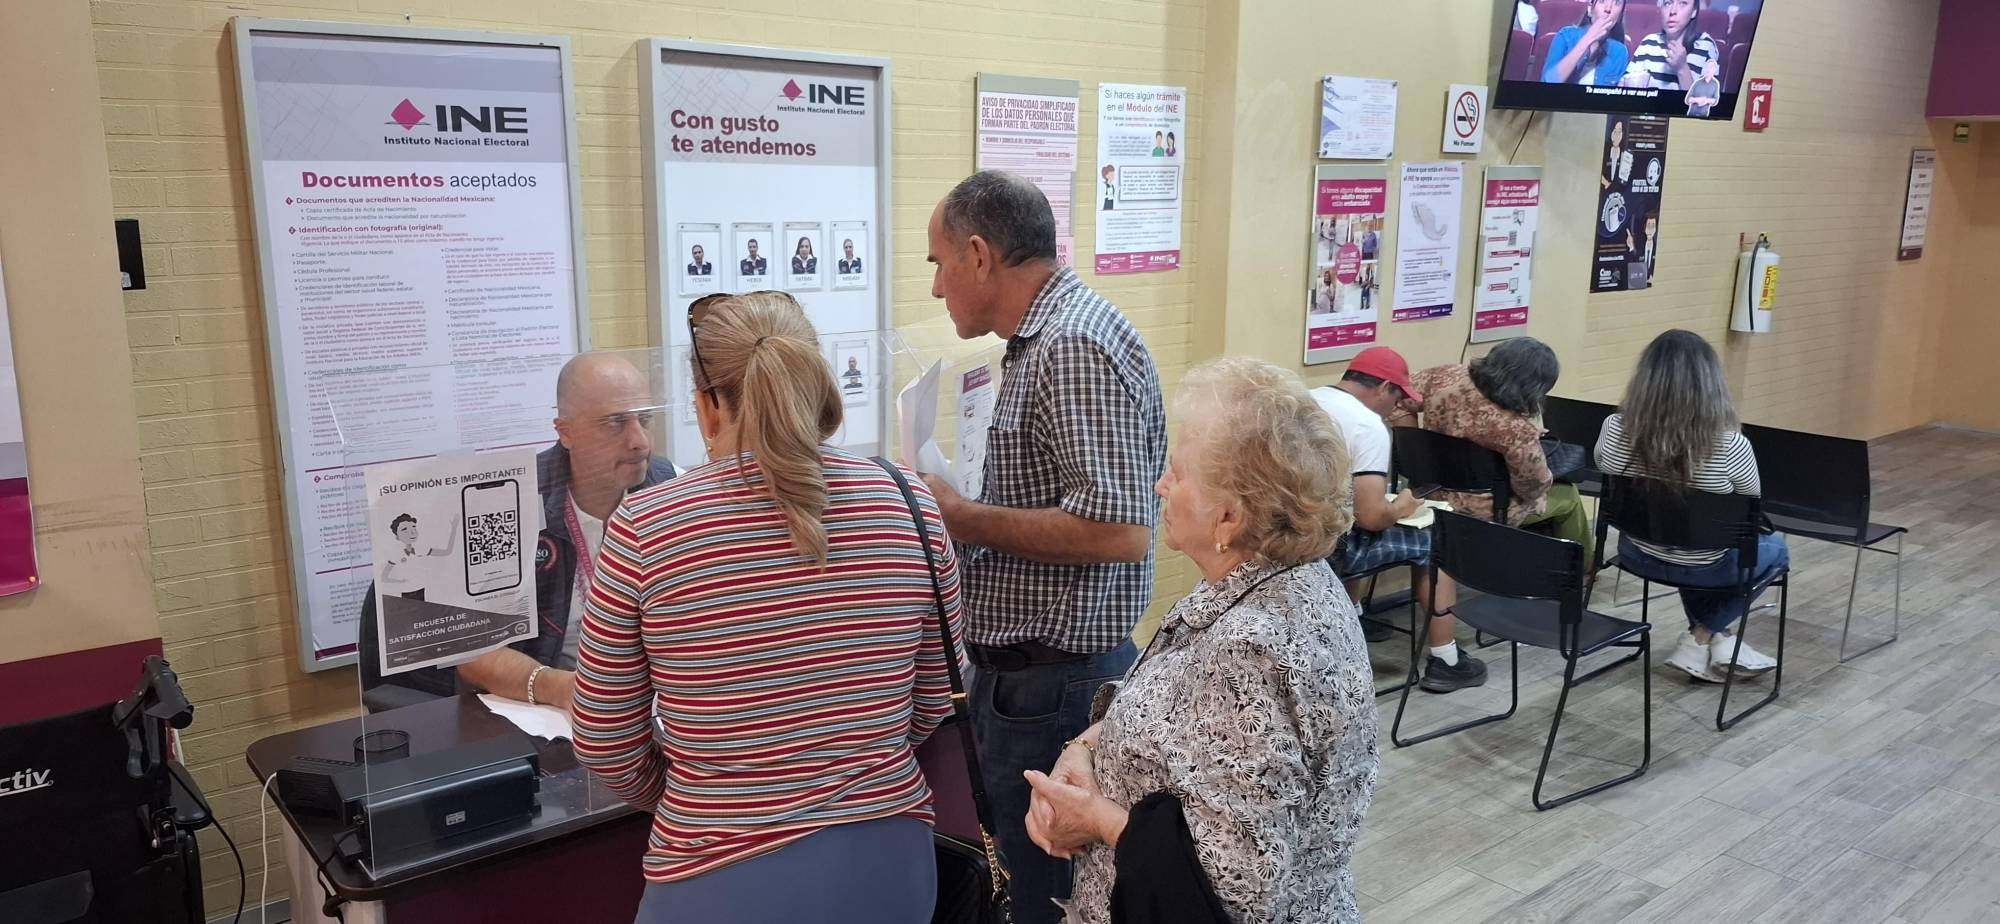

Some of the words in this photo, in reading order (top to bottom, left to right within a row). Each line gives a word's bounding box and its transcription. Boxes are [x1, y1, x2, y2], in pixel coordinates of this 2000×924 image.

[809, 83, 865, 106] INE
[777, 105, 806, 113] Instituto
[807, 105, 836, 114] Nacional
[837, 107, 865, 115] Electoral
[982, 97, 998, 106] AVISO
[999, 98, 1006, 108] DE
[1008, 98, 1038, 110] PRIVACIDAD
[1040, 100, 1076, 112] SIMPLIFICADO
[1166, 104, 1178, 113] INE
[435, 104, 528, 134] INE
[670, 110, 714, 130] Con
[720, 114, 780, 136] gusto
[982, 108, 990, 118] DE
[992, 108, 1003, 118] LOS
[1004, 109, 1024, 120] DATOS
[1024, 110, 1062, 122] PERSONALES
[1063, 112, 1074, 122] QUE
[982, 118, 1003, 128] FORMAN
[1004, 120, 1020, 128] PARTE
[1020, 120, 1028, 130] DEL
[1050, 122, 1076, 131] ELECTORAL
[384, 136, 431, 146] Instituto
[434, 136, 480, 146] Nacional
[484, 138, 529, 147] Electoral
[671, 134, 694, 152] te
[701, 136, 816, 156] atendemos
[302, 171, 444, 188] Documentos
[450, 172, 536, 191] aceptados
[409, 224, 444, 232] (original):
[324, 472, 364, 481] Comproba
[380, 486, 396, 496] ¡SU
[400, 478, 442, 492] OPINIÓN
[445, 476, 458, 485] ES
[460, 467, 526, 484] IMPORTANTE!
[414, 615, 455, 629] ENCUESTA
[456, 613, 467, 621] DE
[389, 628, 446, 644] SATISFACCIÓN
[447, 618, 492, 632] CIUDADANA
[0, 768, 51, 792] ctiv
